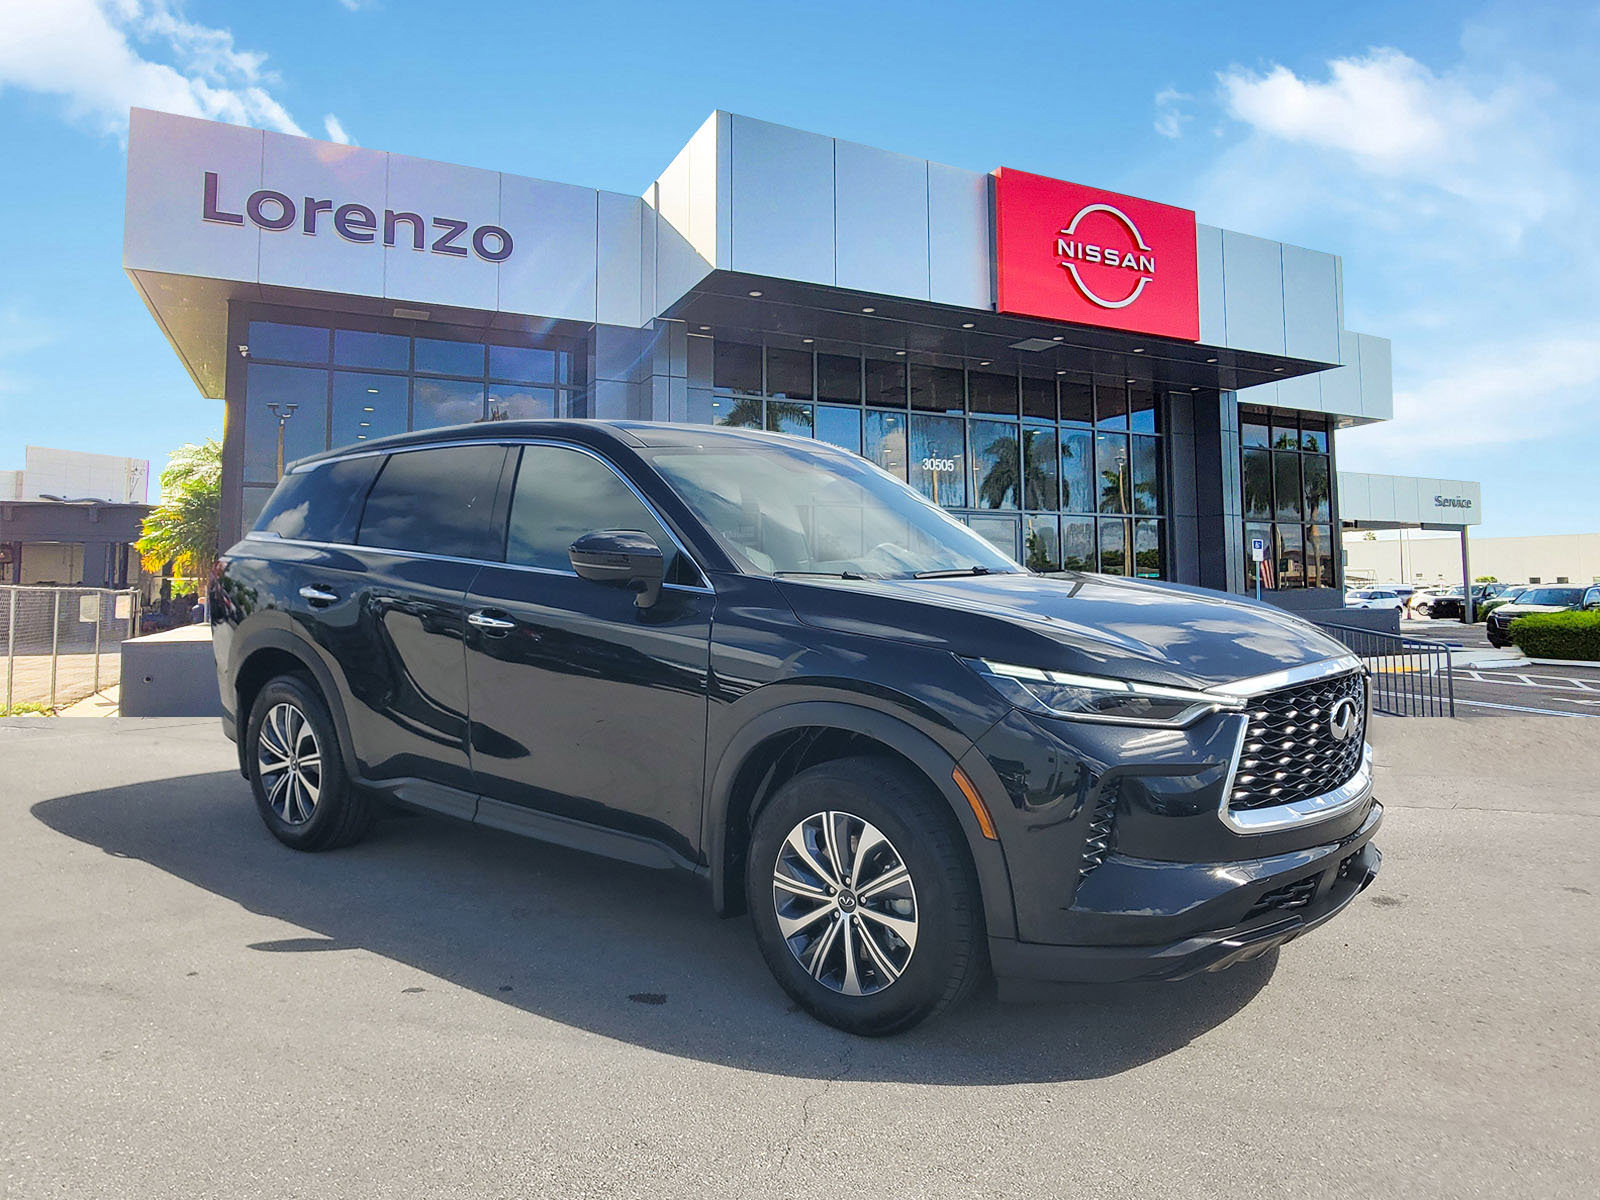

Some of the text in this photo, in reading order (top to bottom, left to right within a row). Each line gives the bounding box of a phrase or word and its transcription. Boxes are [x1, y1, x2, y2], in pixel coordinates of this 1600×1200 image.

[202, 171, 513, 262] Lorenzo
[1057, 238, 1155, 273] NISSAN
[922, 458, 954, 472] 30505
[1434, 495, 1472, 509] Service
